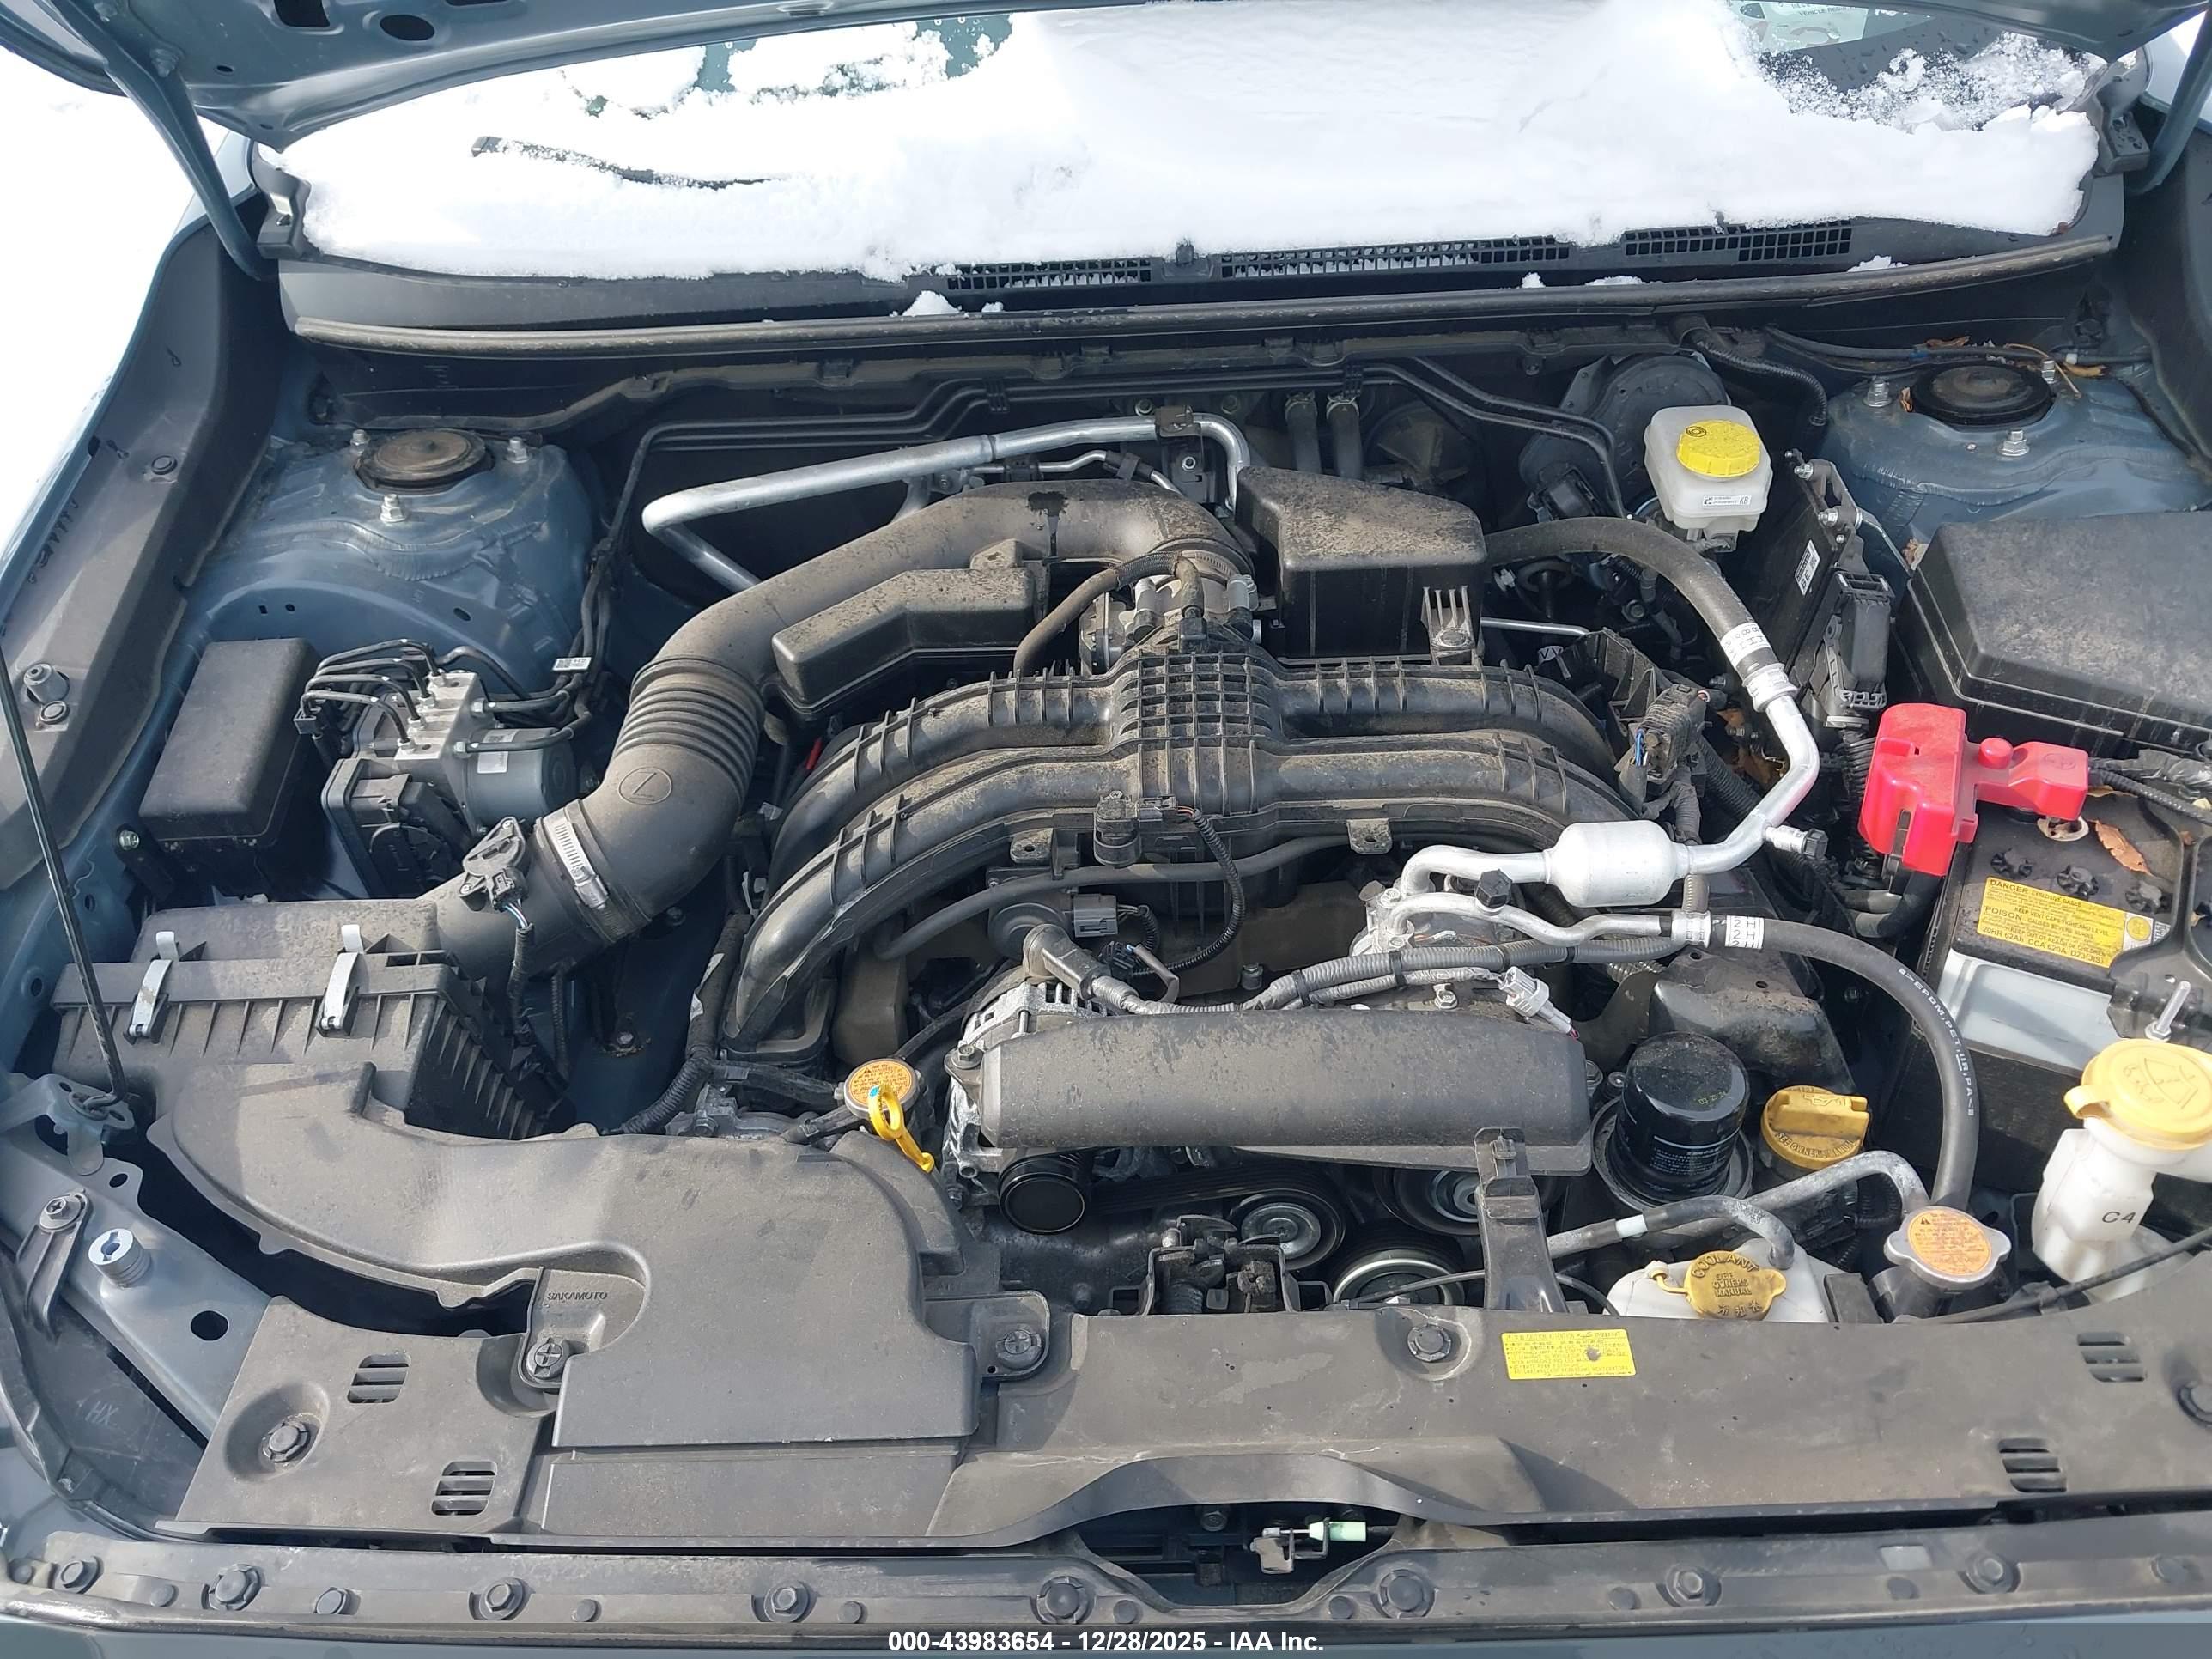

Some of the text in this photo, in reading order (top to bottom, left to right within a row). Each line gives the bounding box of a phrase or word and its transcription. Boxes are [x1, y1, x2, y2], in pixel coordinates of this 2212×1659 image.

[1990, 879, 2029, 895] DANGER
[2062, 898, 2081, 908] GASES
[1984, 905, 2022, 921] POISON
[1733, 918, 1756, 928] 2 H
[1733, 929, 1755, 940] 2 H
[2027, 939, 2046, 948] CCA
[2102, 1203, 2136, 1224] C4
[1692, 1254, 1759, 1278] COOLANT
[1716, 1272, 1735, 1280] SEE
[548, 1291, 608, 1301] SAKAMOTO
[1715, 1287, 1753, 1298] MANUAL
